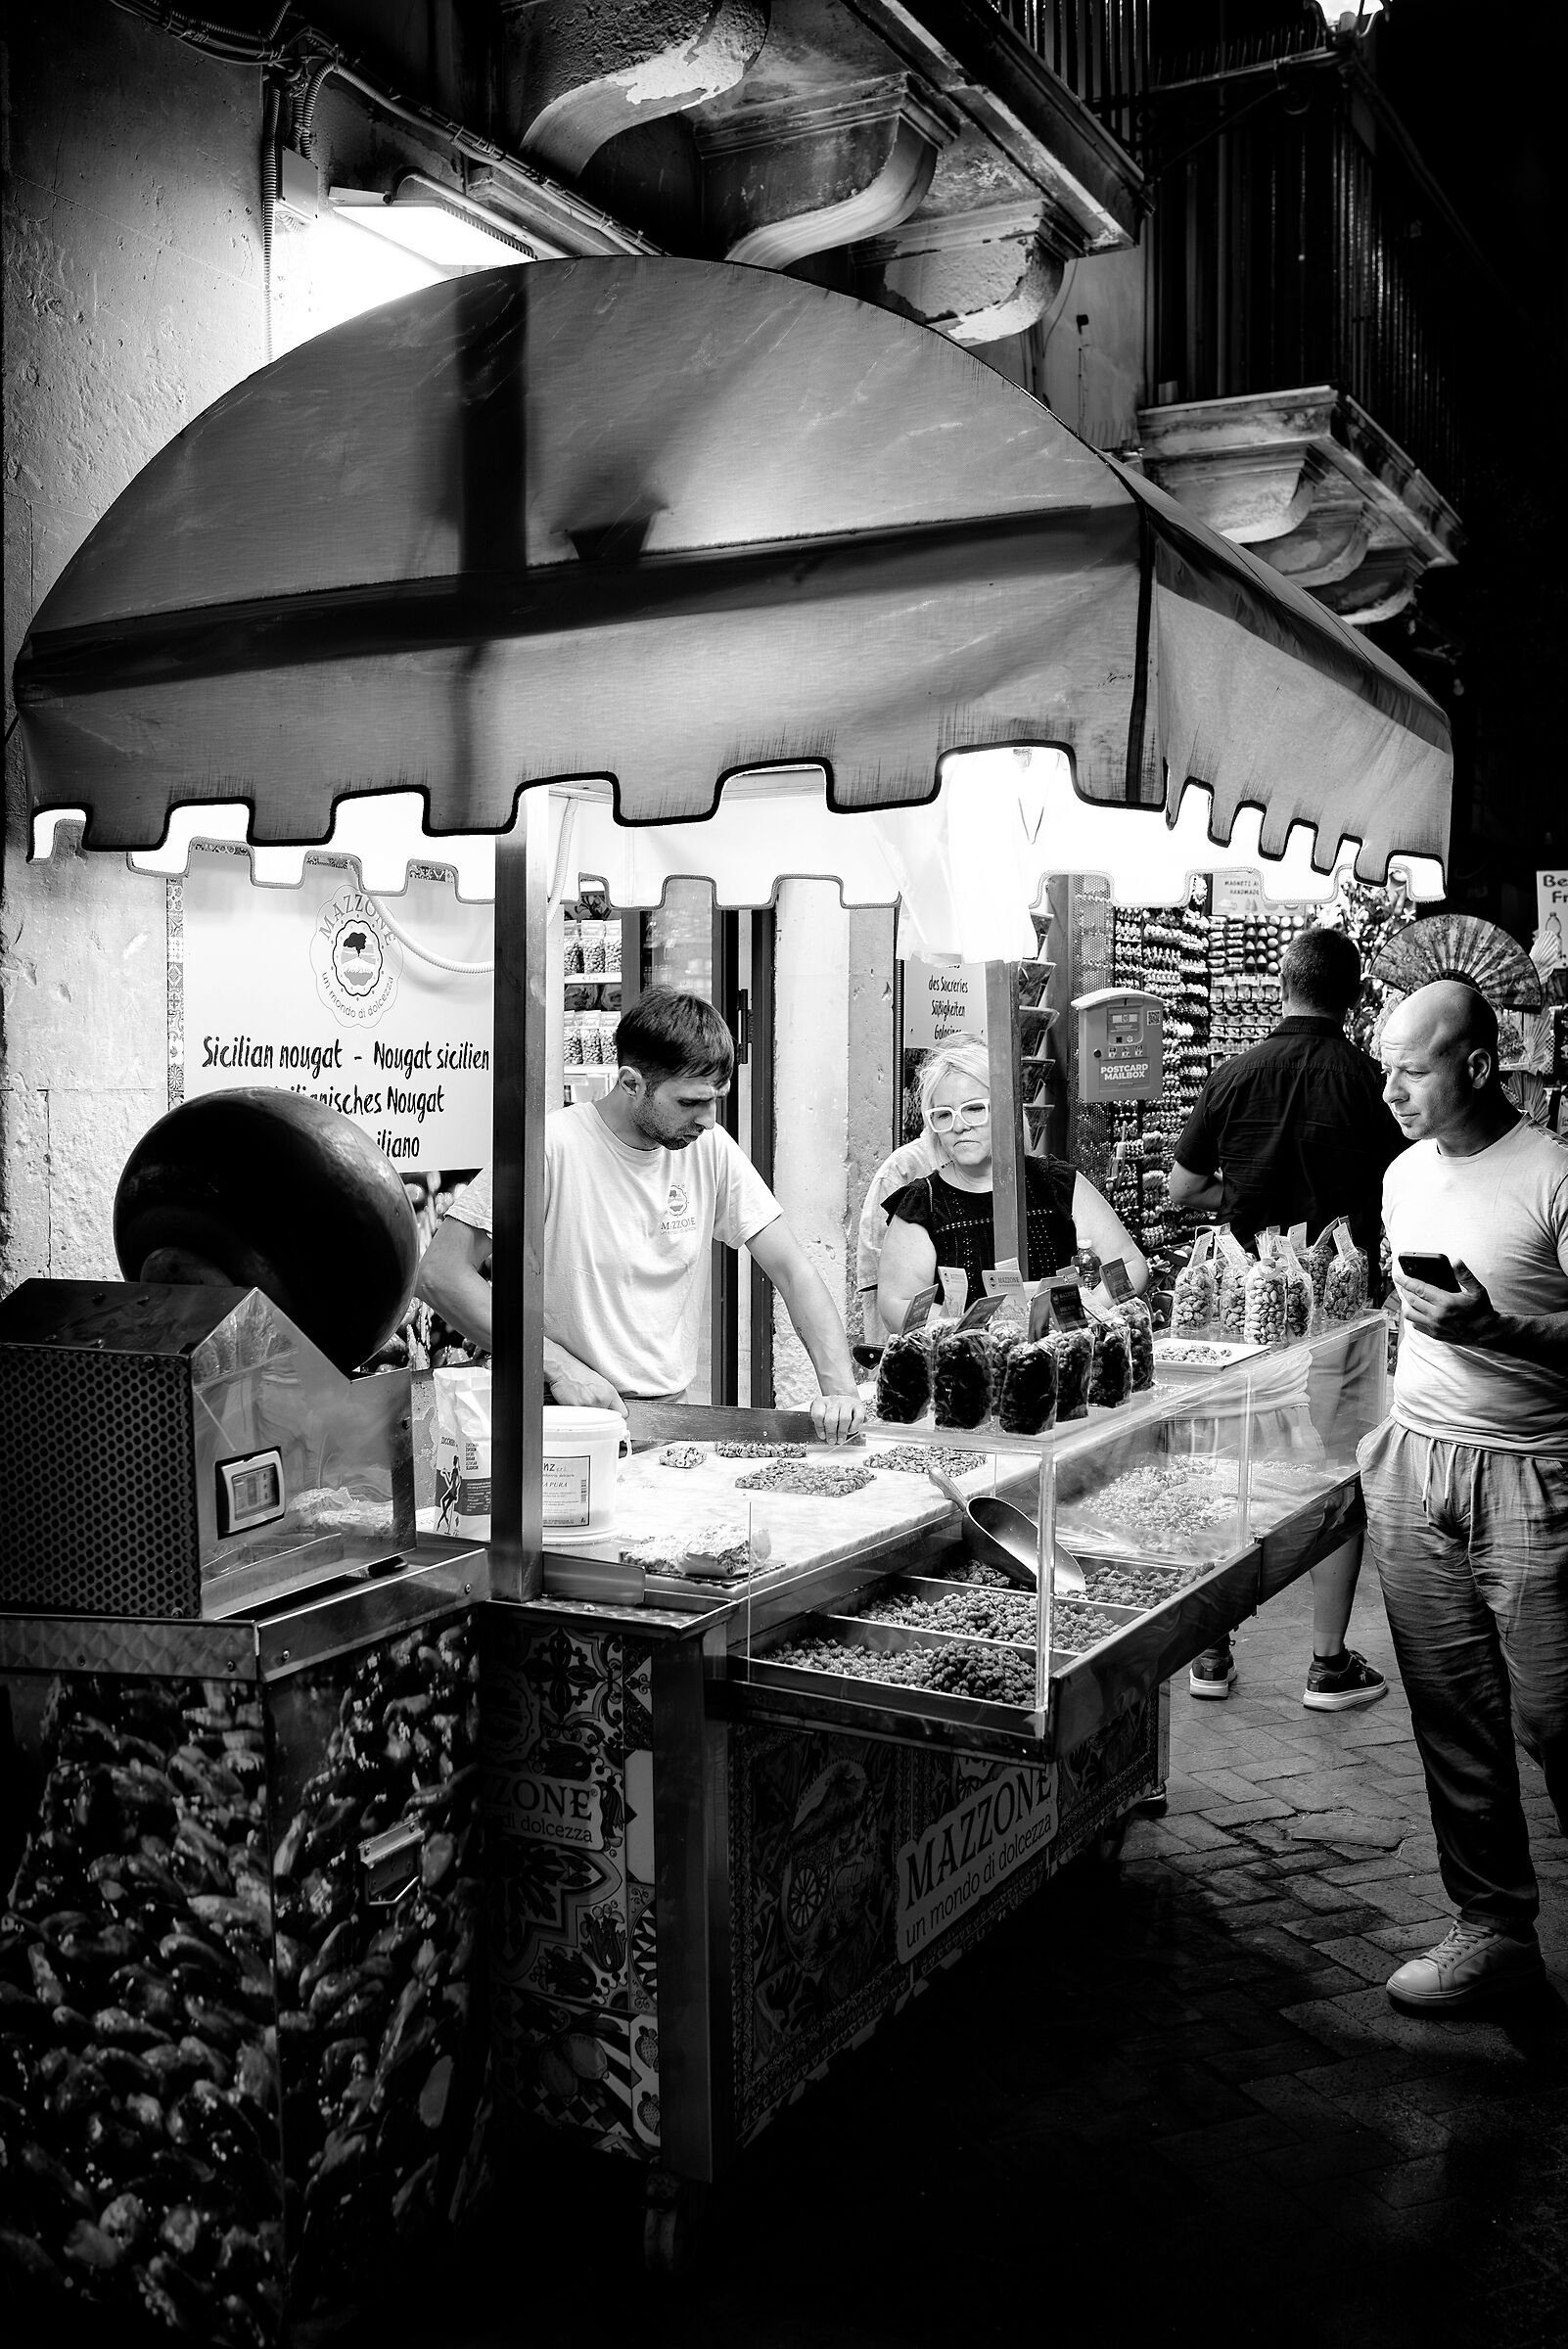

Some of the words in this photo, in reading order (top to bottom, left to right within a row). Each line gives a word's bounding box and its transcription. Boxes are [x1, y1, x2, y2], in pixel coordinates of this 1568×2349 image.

[322, 971, 331, 990] un
[329, 988, 356, 1019] mondo
[358, 1008, 367, 1019] di
[367, 976, 394, 1017] dolcezza
[928, 974, 940, 991] des
[941, 976, 969, 993] Sucreries
[202, 1035, 274, 1069] Sicilian
[279, 1038, 344, 1080] nougat
[373, 1040, 433, 1080] Nougat
[437, 1040, 489, 1072] sicilien
[1100, 1063, 1149, 1075] POSTCARD
[1104, 1071, 1145, 1081] MAILBOX
[387, 1084, 445, 1124] Nougat
[492, 1775, 592, 1821] ZONE
[521, 1816, 593, 1844] dolcezza
[905, 1769, 1052, 1911] MAZZONE
[905, 1916, 926, 1948] un
[930, 1871, 980, 1928] mondo
[983, 1852, 996, 1883] di
[998, 1814, 1052, 1871] dolcezza
